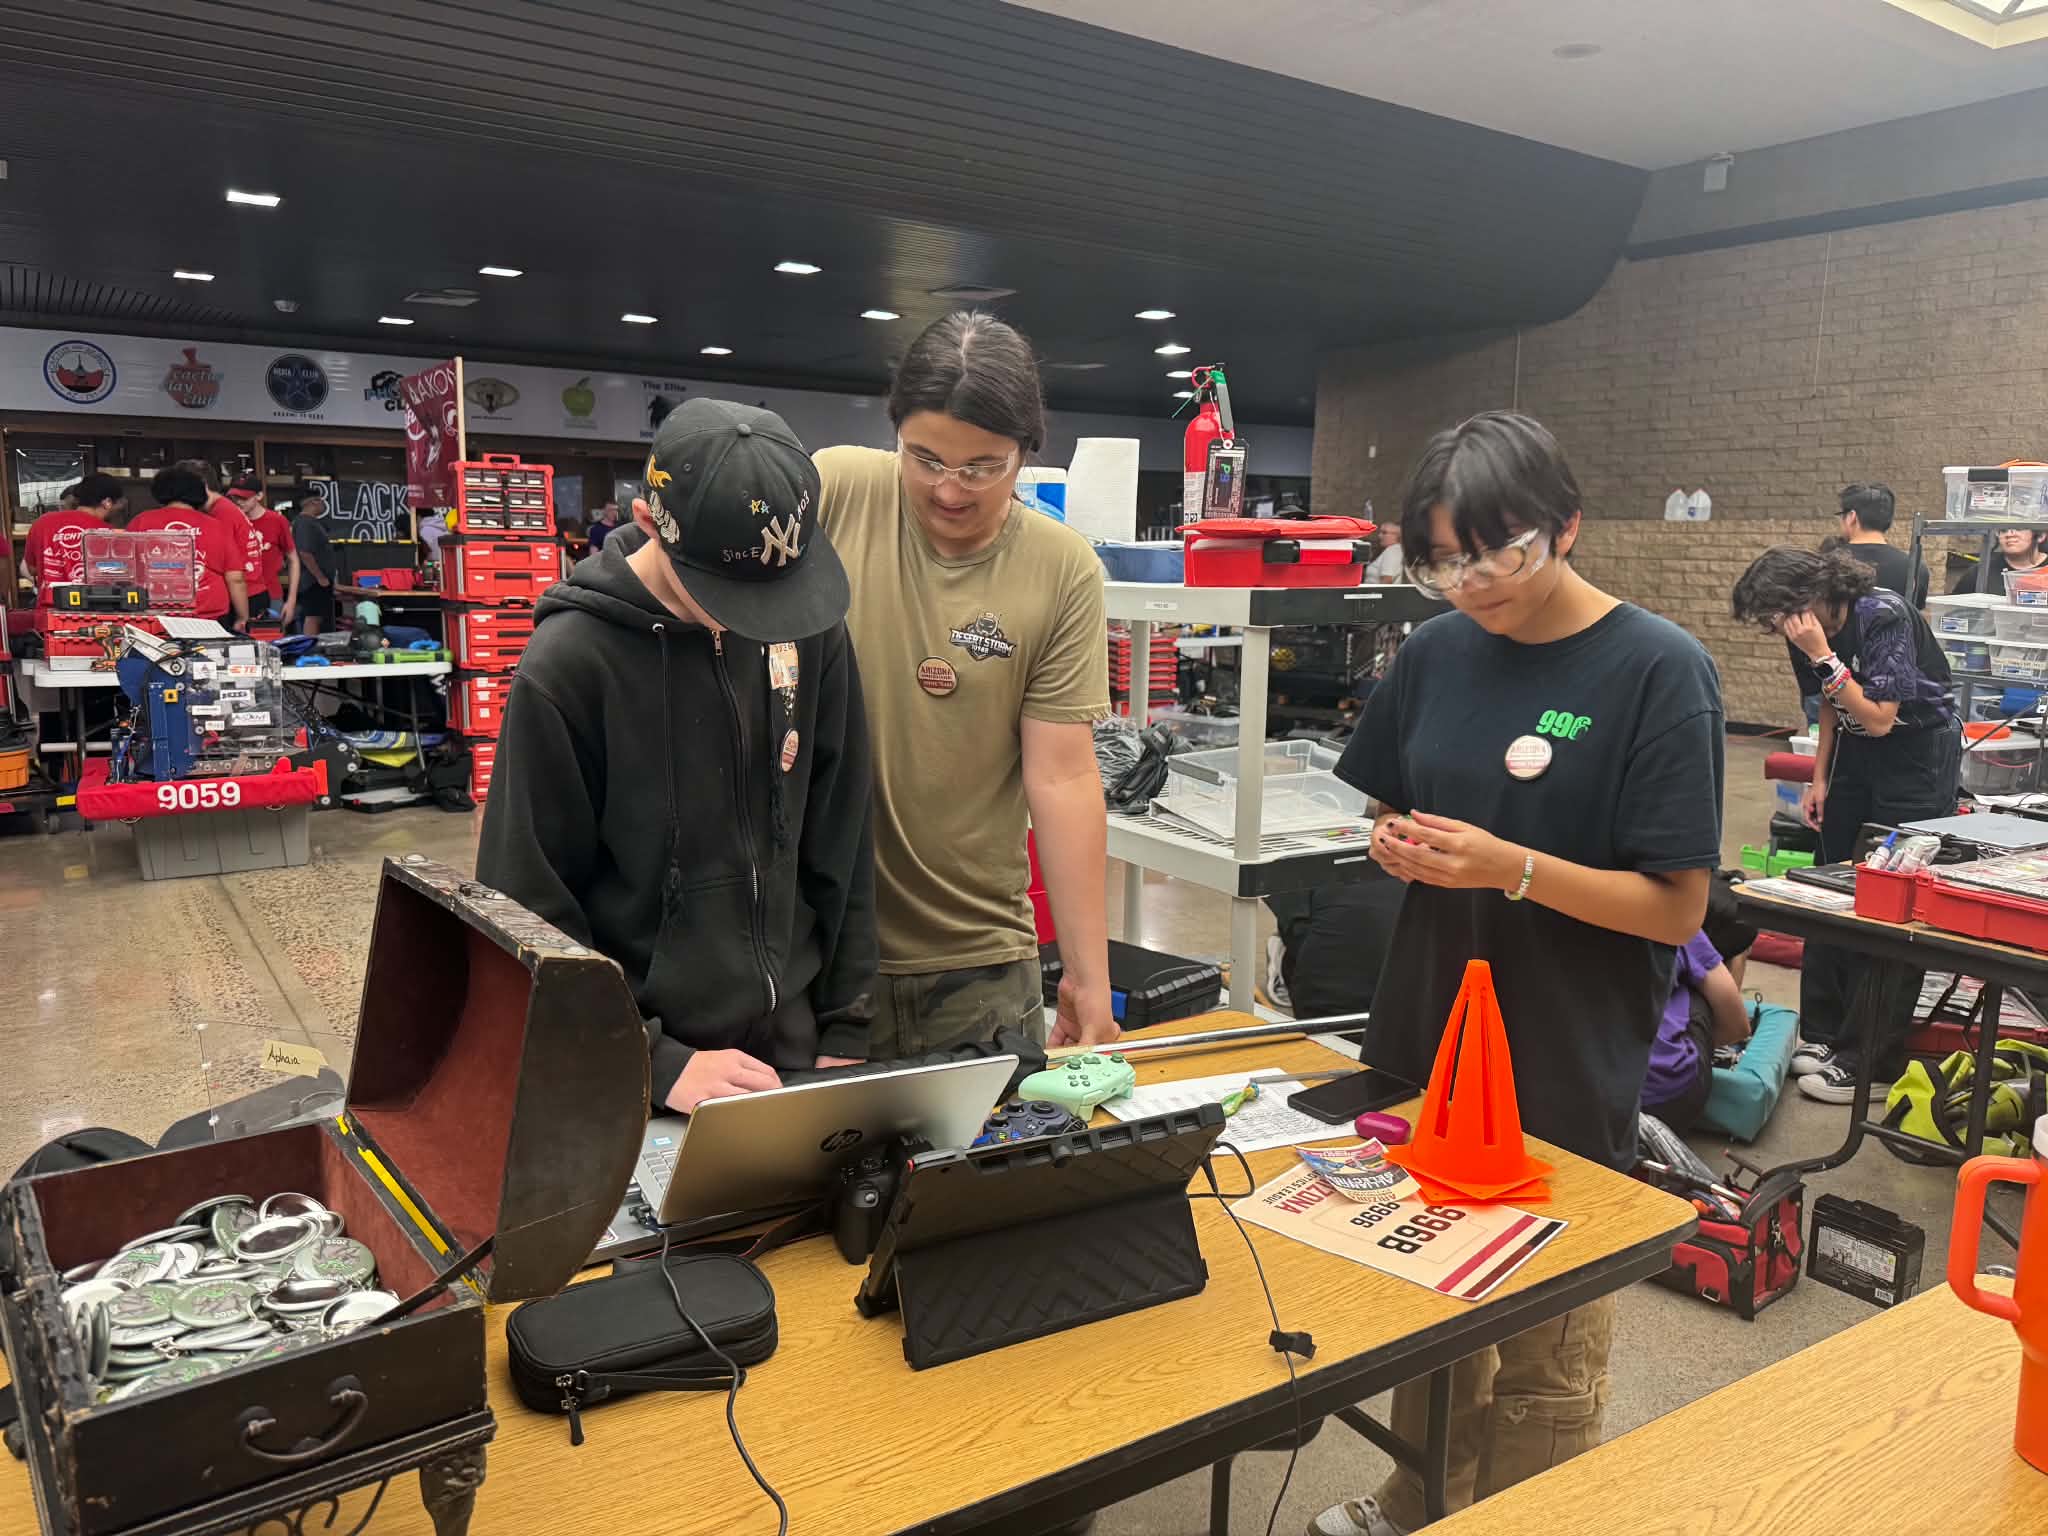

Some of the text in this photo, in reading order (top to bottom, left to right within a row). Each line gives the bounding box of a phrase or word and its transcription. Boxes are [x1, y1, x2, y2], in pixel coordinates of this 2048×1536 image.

[309, 481, 410, 521] BLACK
[761, 514, 801, 567] NY
[157, 781, 240, 810] 9059
[1350, 1202, 1400, 1228] 9996
